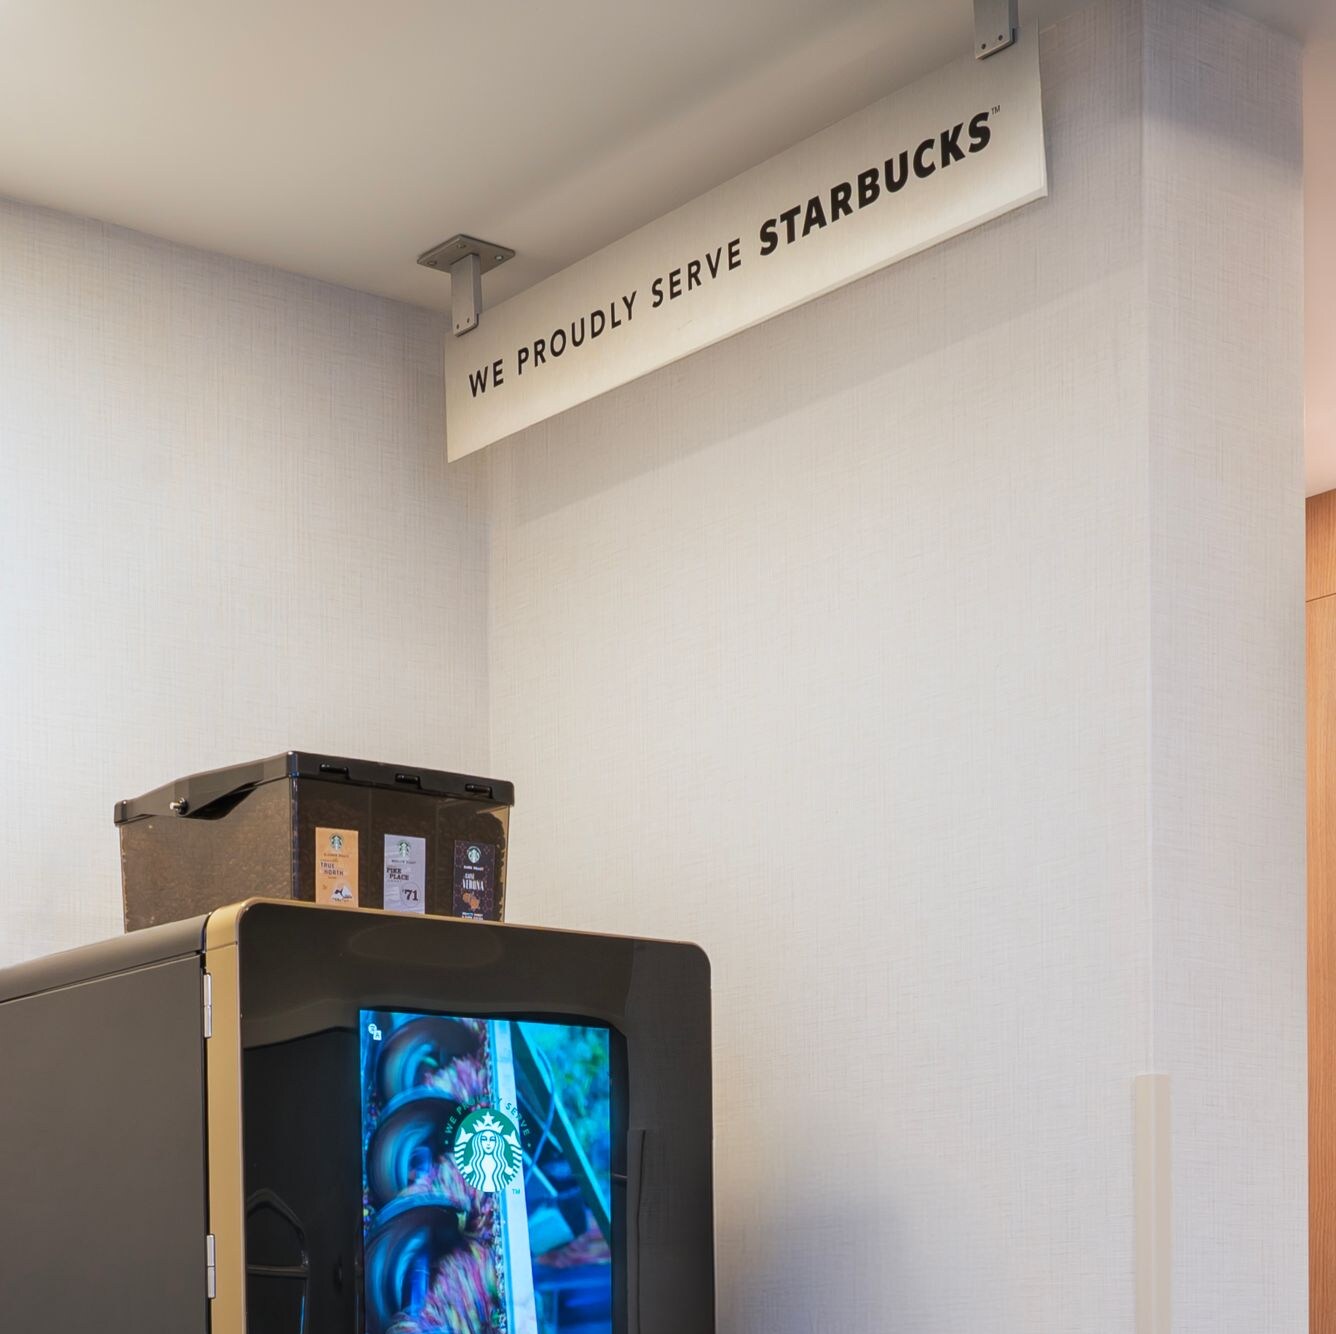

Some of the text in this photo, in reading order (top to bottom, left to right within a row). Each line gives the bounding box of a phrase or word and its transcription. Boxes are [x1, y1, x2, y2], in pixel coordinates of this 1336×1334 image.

[468, 358, 504, 398] WE
[517, 290, 637, 375] PROUDLY
[651, 237, 743, 308] SERVE
[758, 110, 992, 257] STARBUCKS
[444, 1116, 457, 1134] WE
[505, 1102, 531, 1136] SERVE
